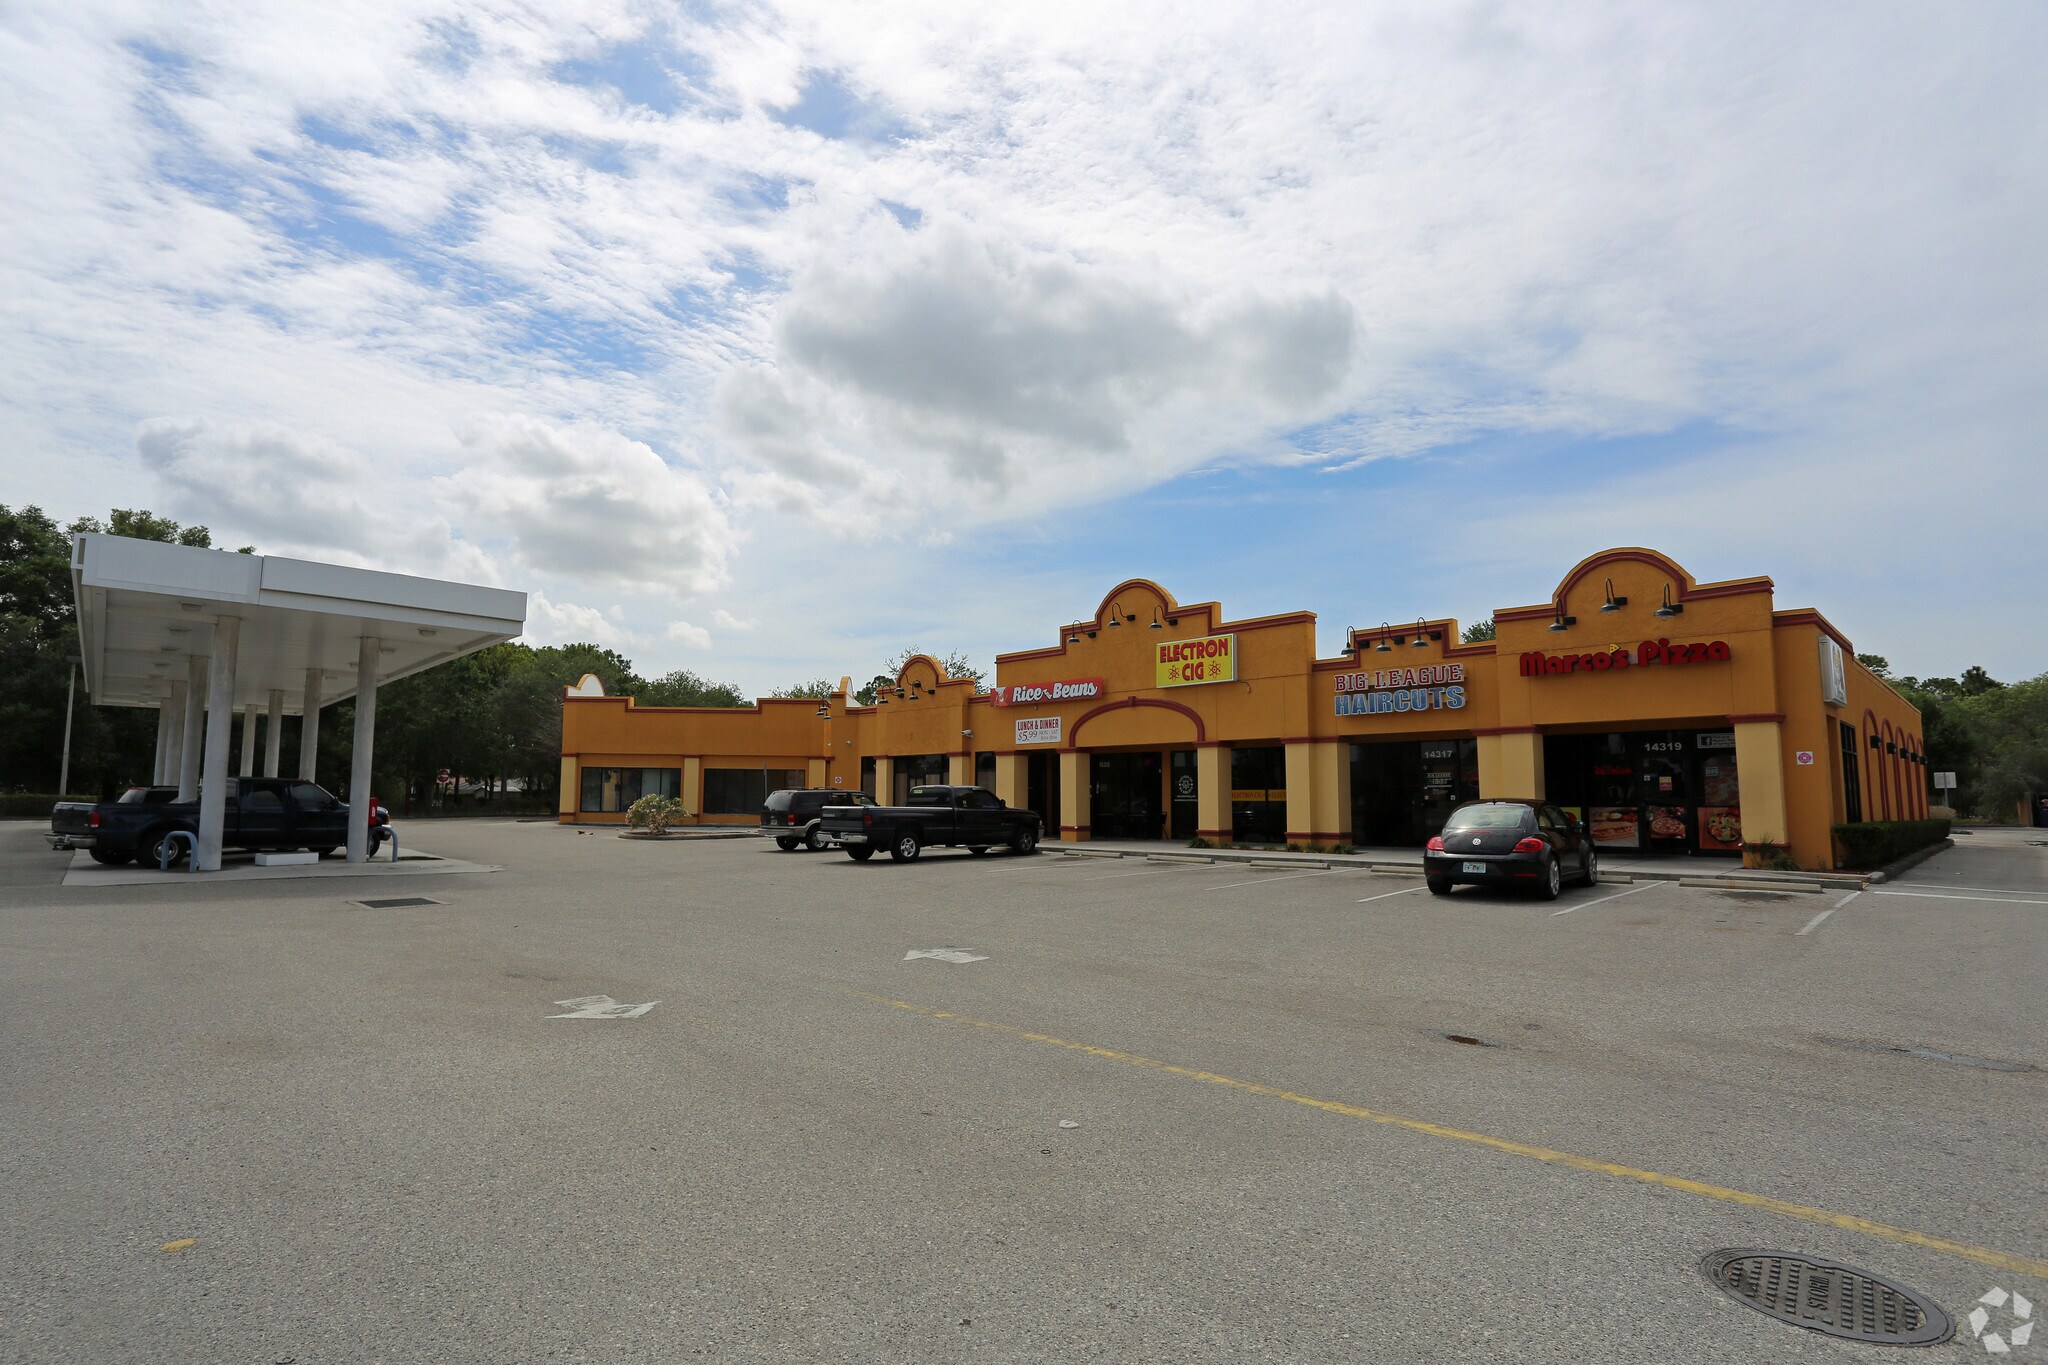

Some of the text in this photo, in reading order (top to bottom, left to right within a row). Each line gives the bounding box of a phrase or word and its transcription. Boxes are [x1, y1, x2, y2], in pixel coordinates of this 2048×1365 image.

[1160, 638, 1228, 663] ELECTRON
[1637, 638, 1730, 667] Pizza
[1182, 662, 1204, 681] CIG
[1335, 663, 1464, 692] BIG LEAGUE
[1013, 685, 1043, 702] Rice
[1052, 682, 1098, 699] Beans
[1335, 685, 1466, 716] HAIRCUTS
[1018, 718, 1059, 731] LUNCH & DINNER
[1424, 750, 1453, 758] 14317
[1644, 742, 1682, 751] 14319
[1807, 1275, 1830, 1311] STORM
